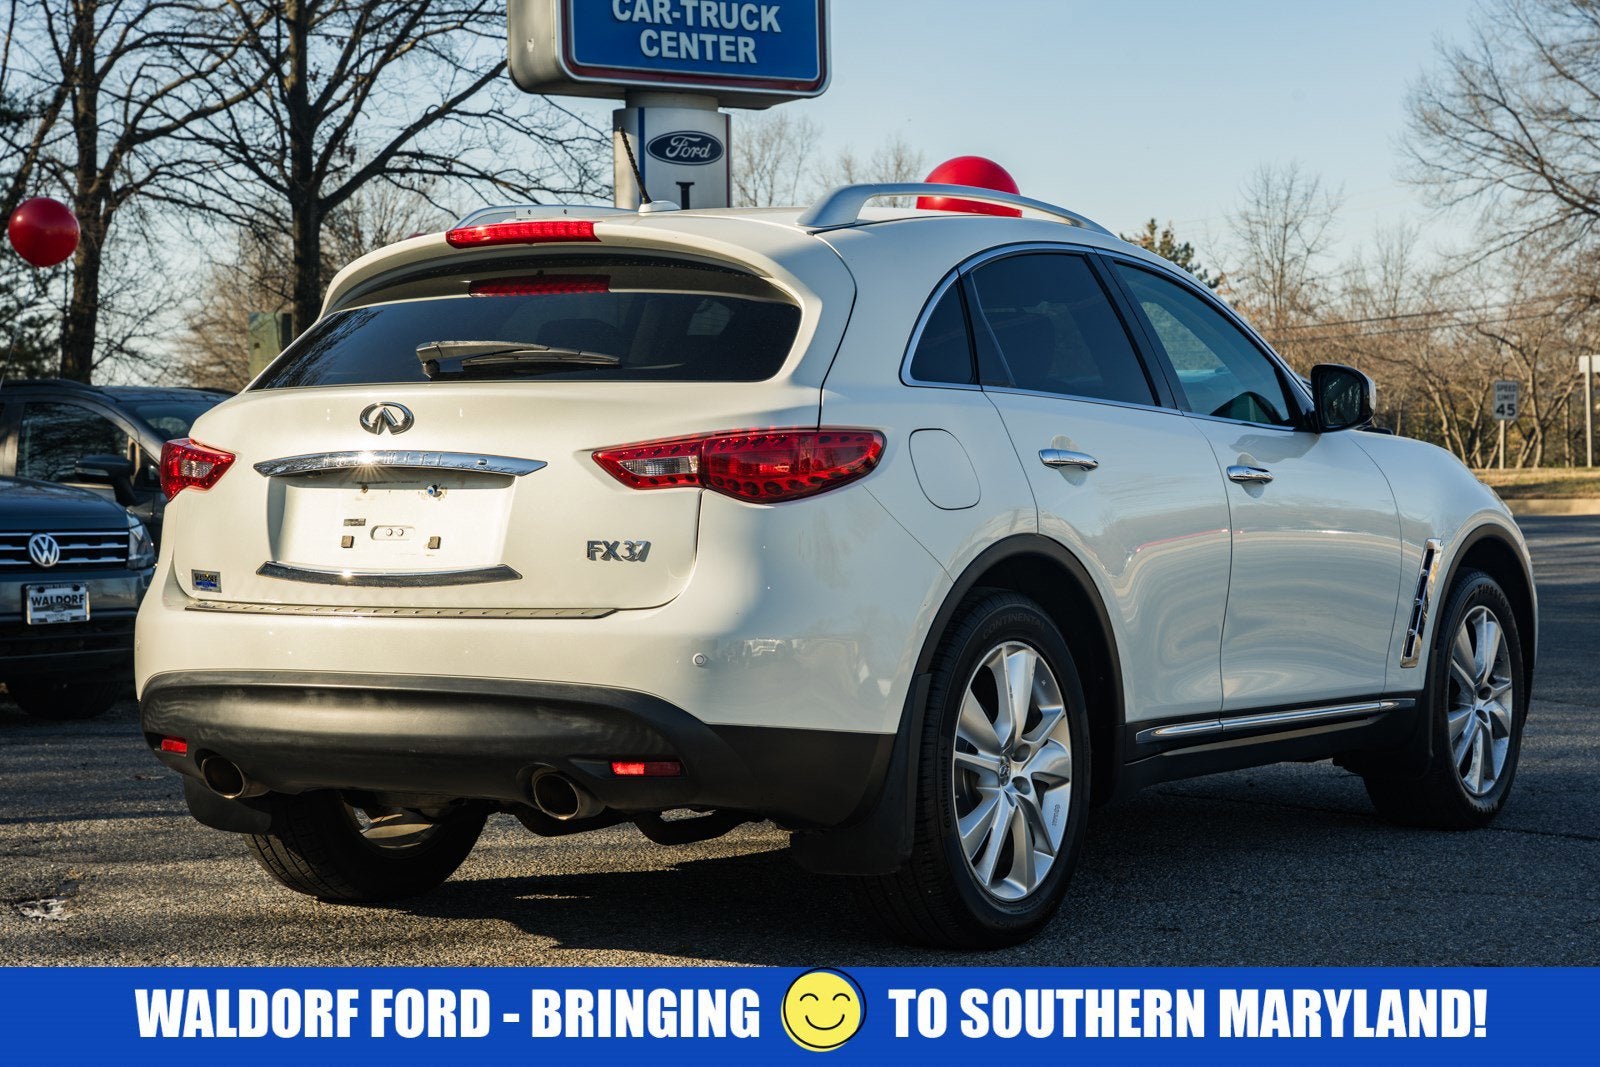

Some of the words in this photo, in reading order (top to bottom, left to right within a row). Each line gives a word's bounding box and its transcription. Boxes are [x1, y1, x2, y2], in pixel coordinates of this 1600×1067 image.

[612, 0, 782, 33] CAR-TRUCK
[639, 29, 758, 64] CENTER
[665, 136, 712, 160] Ford
[1496, 384, 1517, 392] SPEED
[1497, 394, 1515, 402] LIMIT
[1496, 403, 1516, 417] 45
[31, 593, 84, 607] WALDORF
